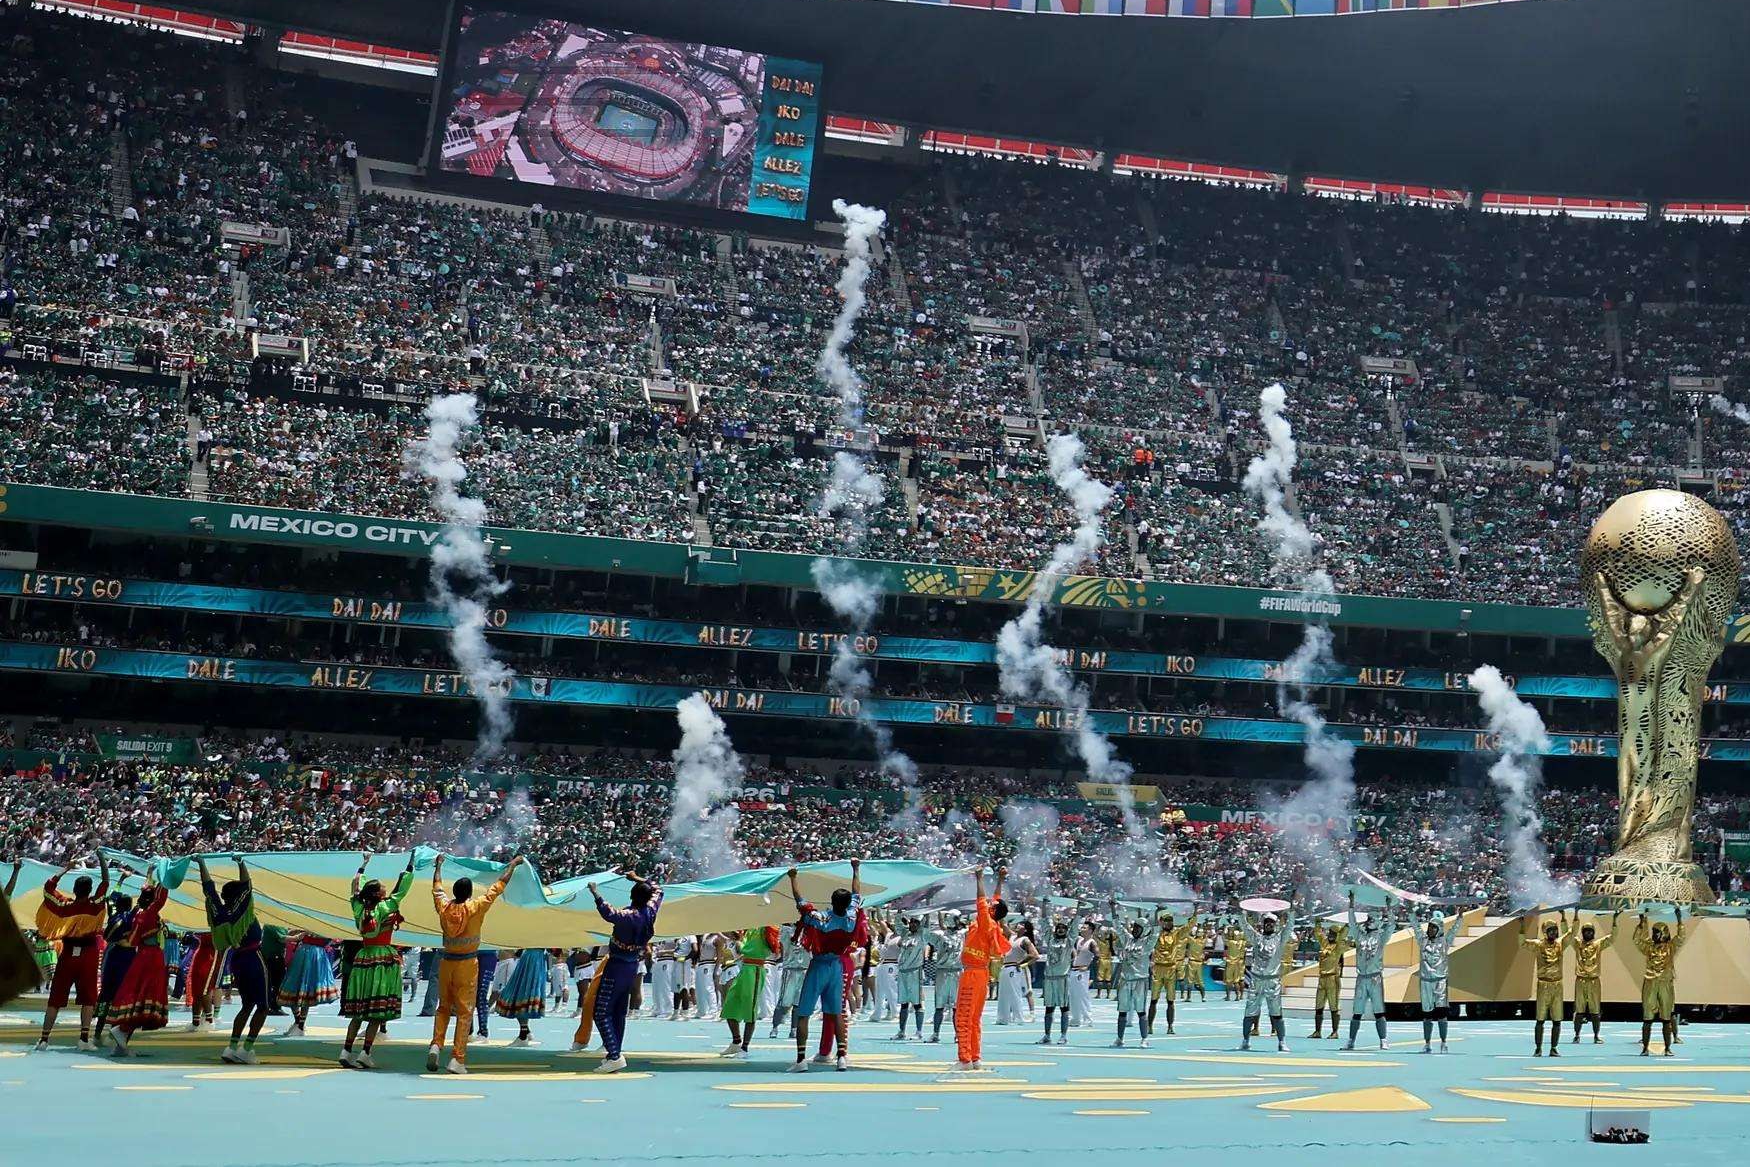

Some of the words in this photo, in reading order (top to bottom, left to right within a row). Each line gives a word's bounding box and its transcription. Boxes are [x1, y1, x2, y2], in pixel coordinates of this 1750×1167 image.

[777, 105, 801, 119] IKO
[763, 155, 802, 173] ALLEZ
[229, 513, 358, 538] MEXICO
[365, 525, 439, 546] CITY
[22, 573, 86, 597] LET'S
[92, 579, 122, 600] GO
[333, 597, 364, 617] DAI
[371, 602, 401, 622] DAI
[1259, 596, 1341, 616] #FIFAWorldCup
[589, 618, 631, 638] DALE
[699, 625, 752, 647] ALLEZ
[854, 635, 877, 654] GO
[57, 647, 97, 671] IKO
[188, 658, 236, 680] DALE
[1081, 651, 1106, 669] DAI
[1167, 655, 1195, 674] IKO
[311, 666, 372, 691] ALLEZ
[1358, 667, 1405, 687] ALLEZ
[736, 691, 763, 711] DAI
[934, 704, 973, 724] DALE
[1129, 715, 1174, 736] LET'S
[1180, 718, 1203, 736] GO
[147, 742, 166, 752] EXIT
[1364, 727, 1387, 745] DAI
[1394, 730, 1417, 747] DAI
[1570, 738, 1605, 755] DALE
